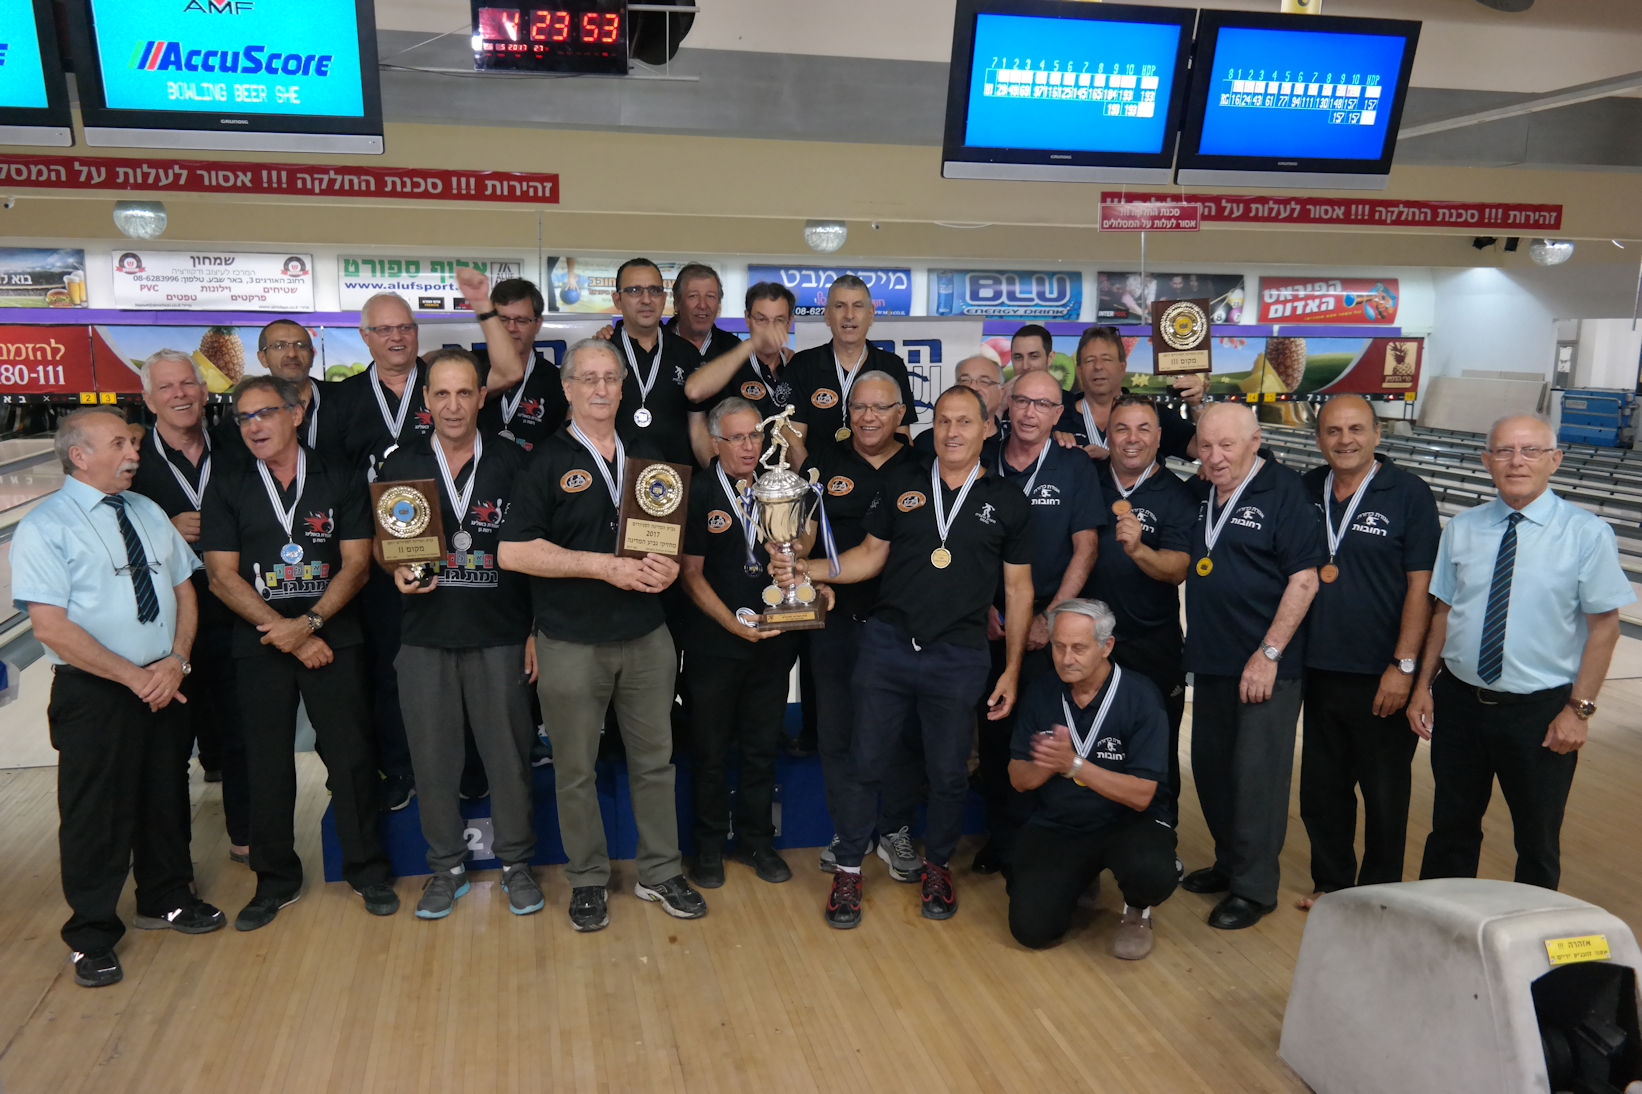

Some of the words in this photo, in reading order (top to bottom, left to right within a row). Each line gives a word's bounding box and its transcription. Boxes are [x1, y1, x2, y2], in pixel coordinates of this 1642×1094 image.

[184, 0, 255, 15] AMF
[532, 10, 570, 40] 23
[583, 12, 619, 42] 53
[1126, 64, 1135, 75] 10
[1352, 74, 1360, 85] 10
[167, 81, 226, 101] BOWLING
[234, 84, 267, 102] BEER
[276, 86, 301, 104] SHE
[1364, 99, 1377, 111] 157
[74, 161, 106, 184] על
[116, 164, 188, 185] לעלות
[197, 170, 252, 188] אסור
[261, 170, 287, 189] !!!
[297, 170, 375, 194] החלקה
[385, 176, 443, 194] סכנת
[451, 177, 476, 195] !!!
[485, 180, 552, 198] זהירות
[1160, 208, 1180, 217] סכנת
[1221, 199, 1243, 217] על
[1250, 201, 1301, 218] לעלות
[1306, 204, 1345, 219] אסור
[1375, 203, 1431, 224] החלקה
[1436, 208, 1479, 223] סכנת
[1153, 218, 1176, 228] לעלות
[1178, 220, 1196, 228] אסור
[1508, 211, 1557, 225] זהירות
[190, 255, 235, 269] שמחון
[344, 258, 420, 279] ספורט
[140, 284, 159, 292] PVC
[966, 272, 1070, 306] BLU
[1263, 280, 1342, 303] הפיראט
[1268, 296, 1336, 318] האדום
[1231, 517, 1261, 530] רחובות
[1352, 523, 1387, 536] רחובות
[646, 530, 660, 538] 2017
[464, 570, 499, 582] רמת
[1096, 751, 1125, 760] רחובות
[463, 828, 483, 850] 2
